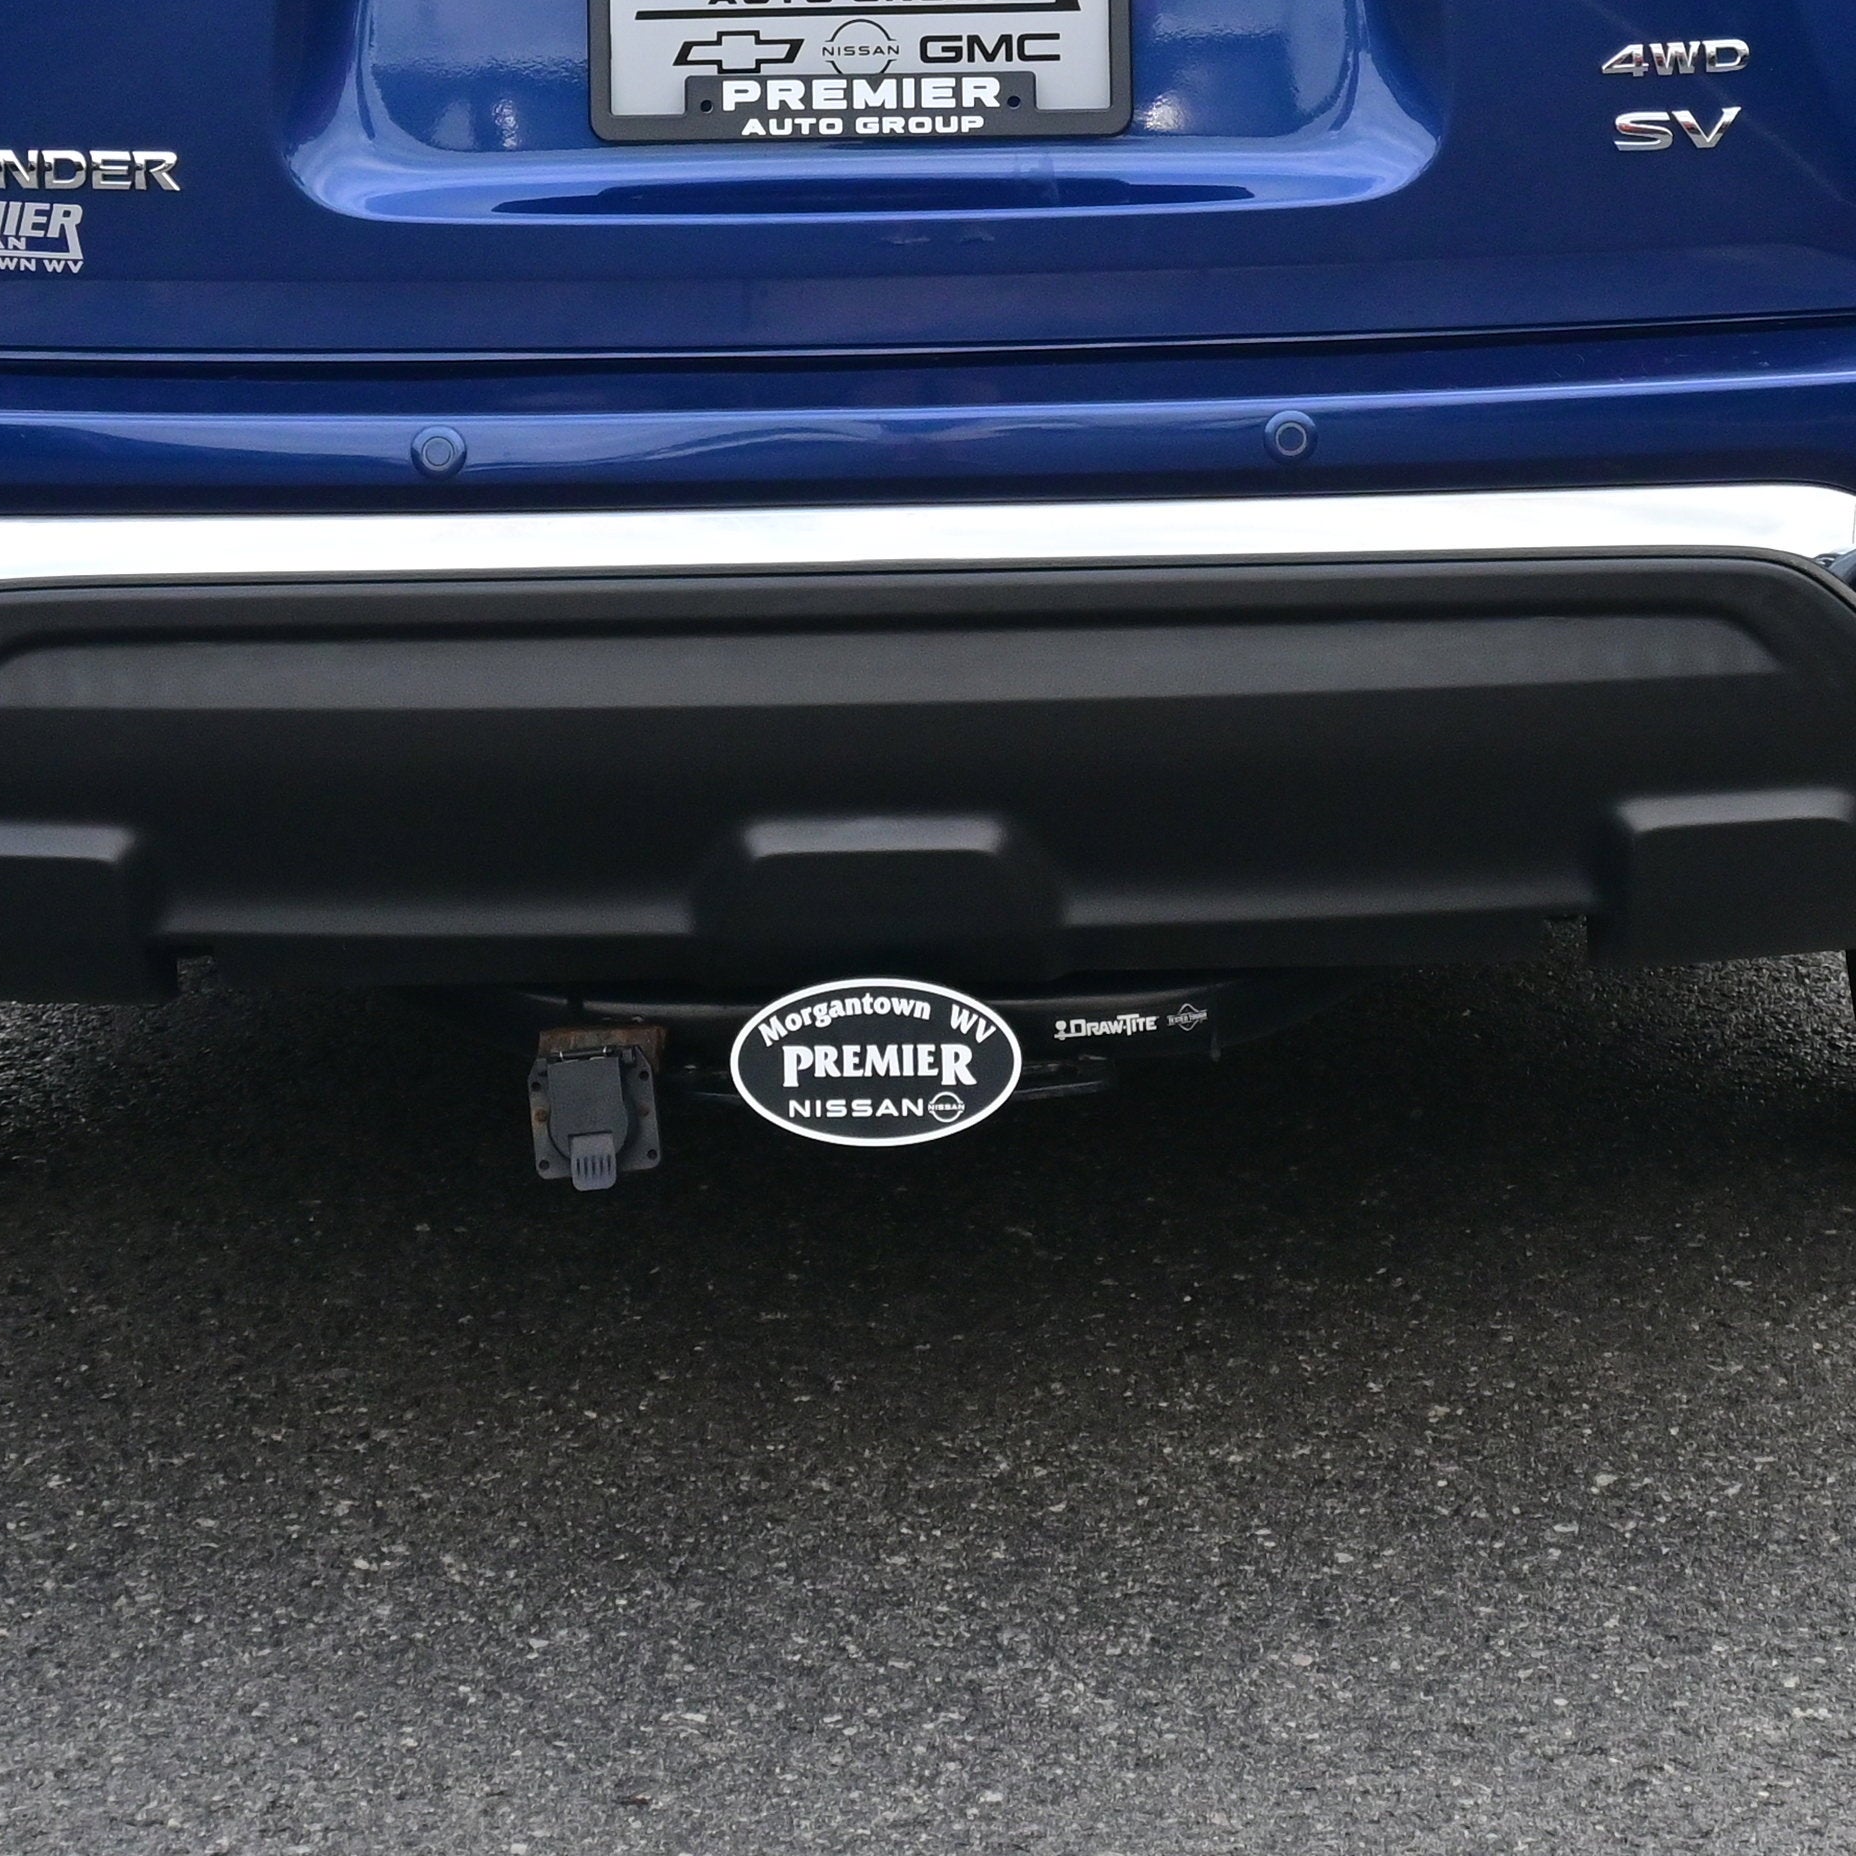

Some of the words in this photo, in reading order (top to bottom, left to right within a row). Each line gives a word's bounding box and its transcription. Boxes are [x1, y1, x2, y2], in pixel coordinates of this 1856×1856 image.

[821, 44, 900, 58] NISSAN
[919, 32, 1062, 63] GMC
[1601, 38, 1750, 77] 4WD
[722, 76, 1001, 112] PREMIER
[741, 116, 844, 136] AUTO
[855, 114, 985, 135] GROUP
[1614, 106, 1742, 152] SV
[42, 259, 84, 273] WV
[757, 992, 932, 1047] Morgantown
[948, 1003, 997, 1045] WV
[782, 1043, 978, 1087] PREMIER
[788, 1098, 924, 1118] NISSAN
[928, 1103, 966, 1111] NISSAN
